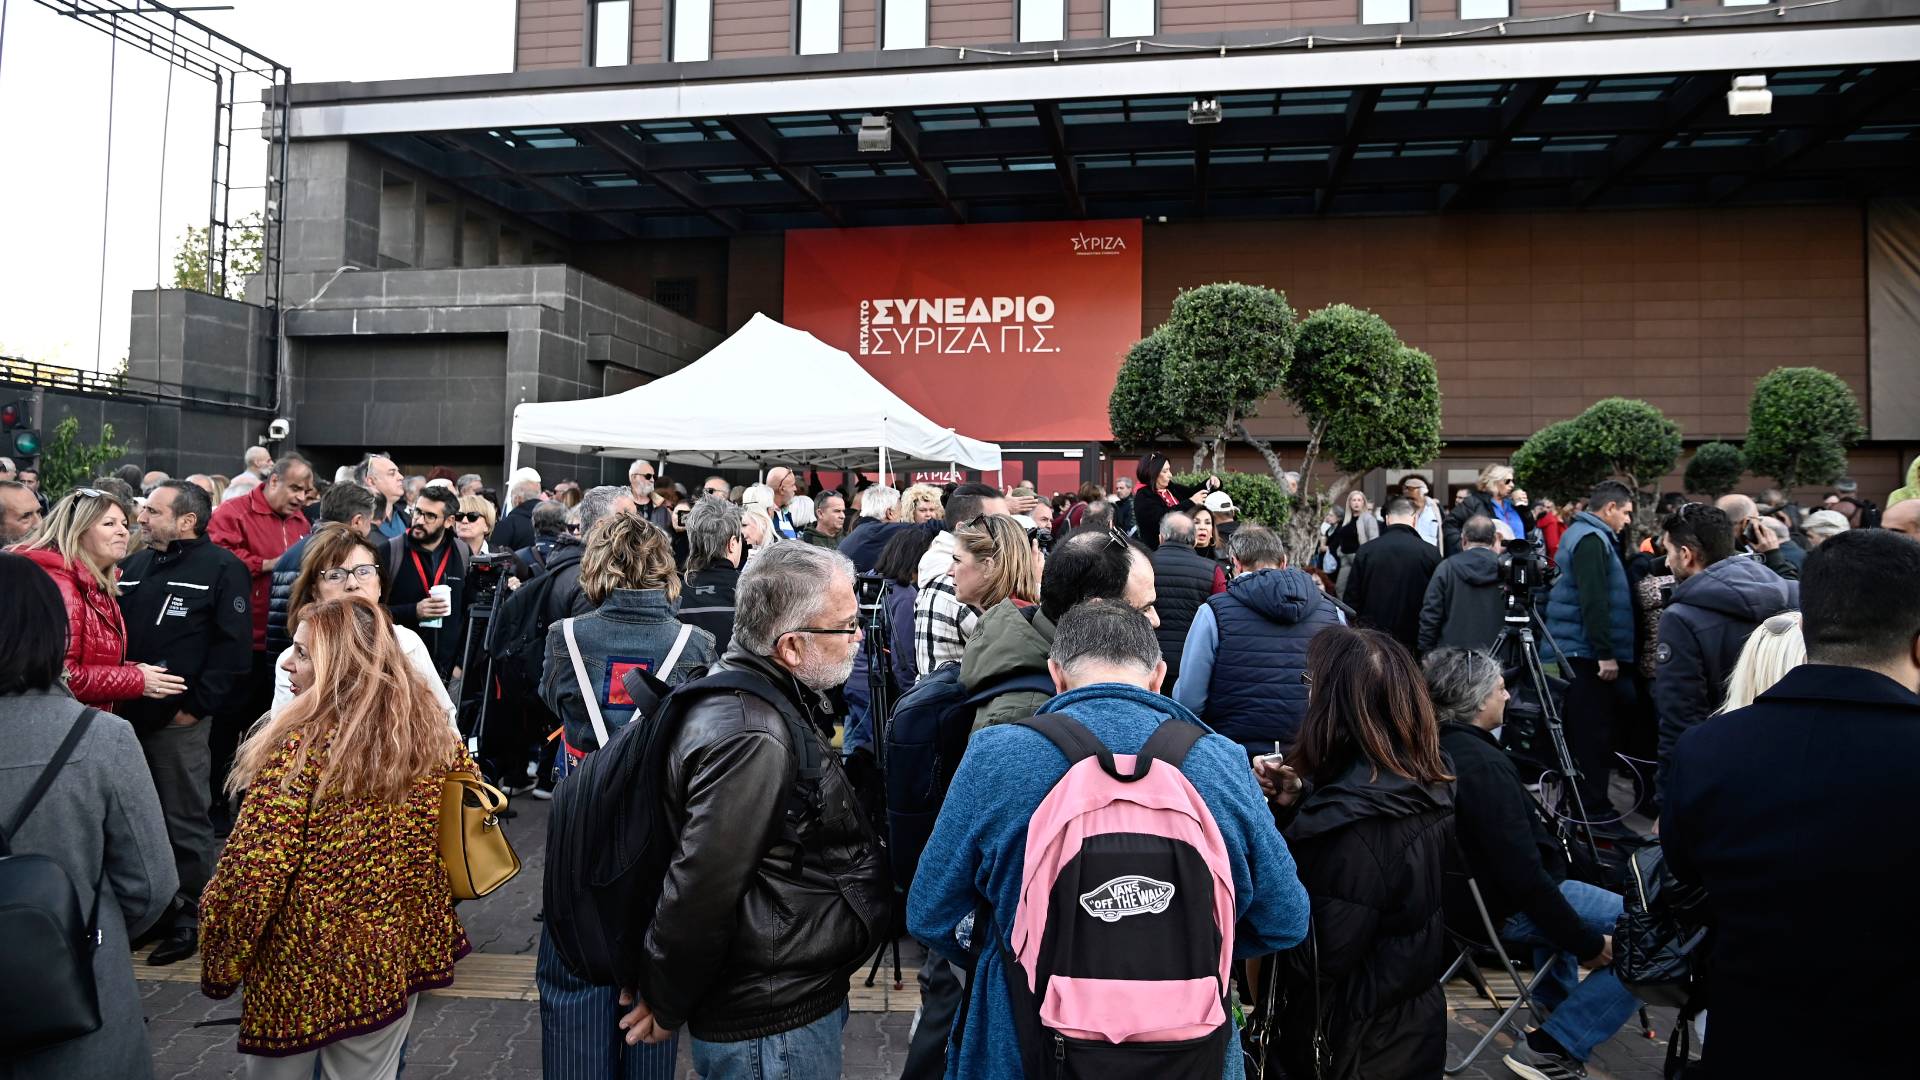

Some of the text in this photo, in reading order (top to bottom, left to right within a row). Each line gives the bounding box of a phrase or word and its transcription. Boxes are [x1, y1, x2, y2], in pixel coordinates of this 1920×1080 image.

[1070, 232, 1126, 250] ΣΥΡΙΖΑ
[871, 295, 1055, 325] ΣΥΝΕΔΡΙΟ
[859, 300, 869, 355] ΕΚΤΑΚΤΟ
[871, 325, 1061, 355] ΣΥΡΙΖΑ Π.Σ.
[1107, 881, 1140, 898] VANS
[1113, 893, 1139, 909] THE
